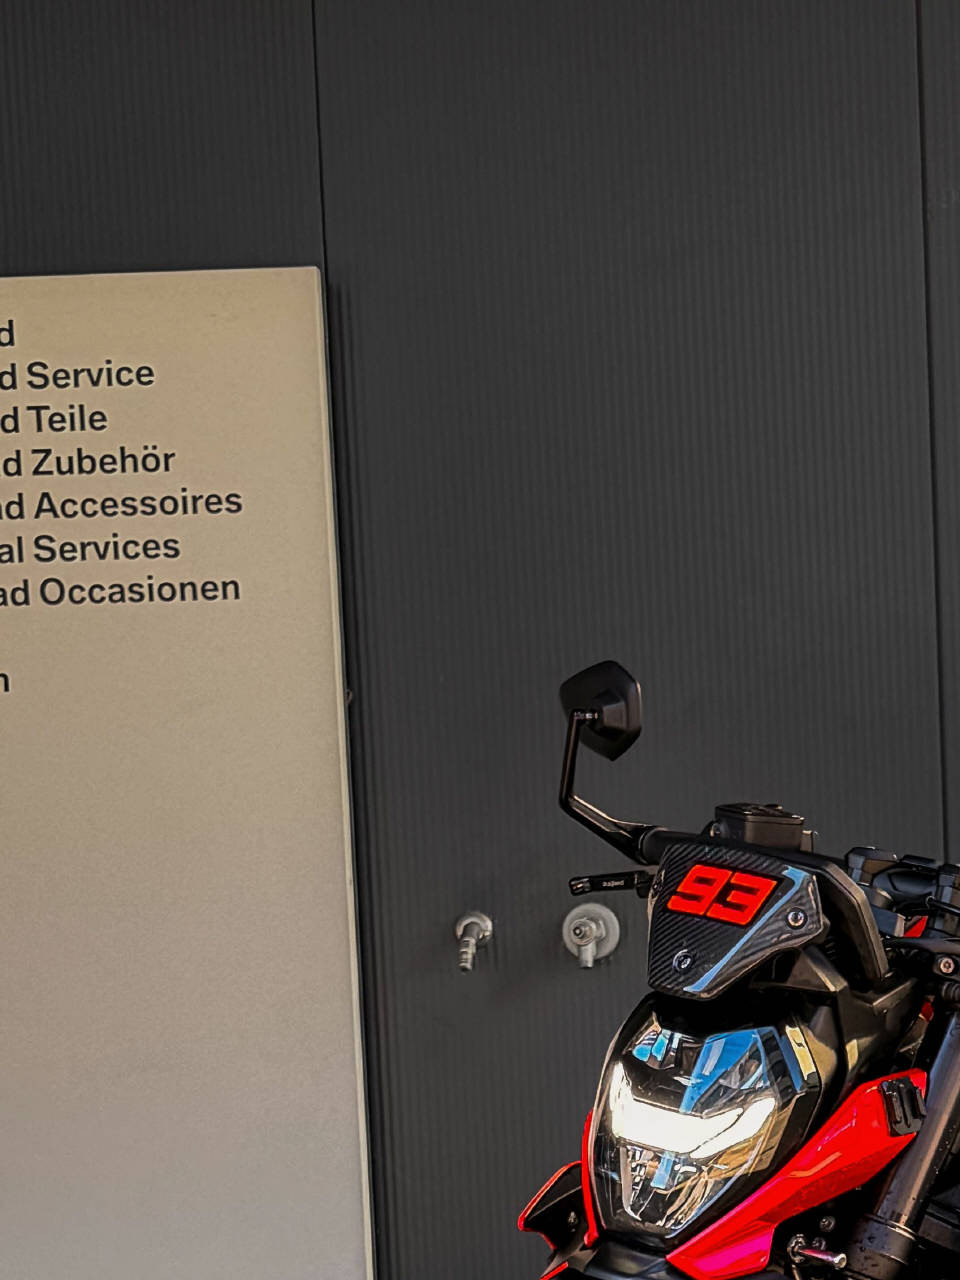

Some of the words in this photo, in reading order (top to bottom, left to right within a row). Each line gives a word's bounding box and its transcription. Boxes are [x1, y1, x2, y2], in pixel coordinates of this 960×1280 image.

[27, 360, 155, 390] Service
[26, 403, 108, 433] Teile
[31, 445, 176, 476] Zubehör
[34, 487, 243, 520] Accessoires
[33, 532, 181, 563] Services
[39, 575, 240, 607] Occasionen
[667, 864, 778, 926] 93
